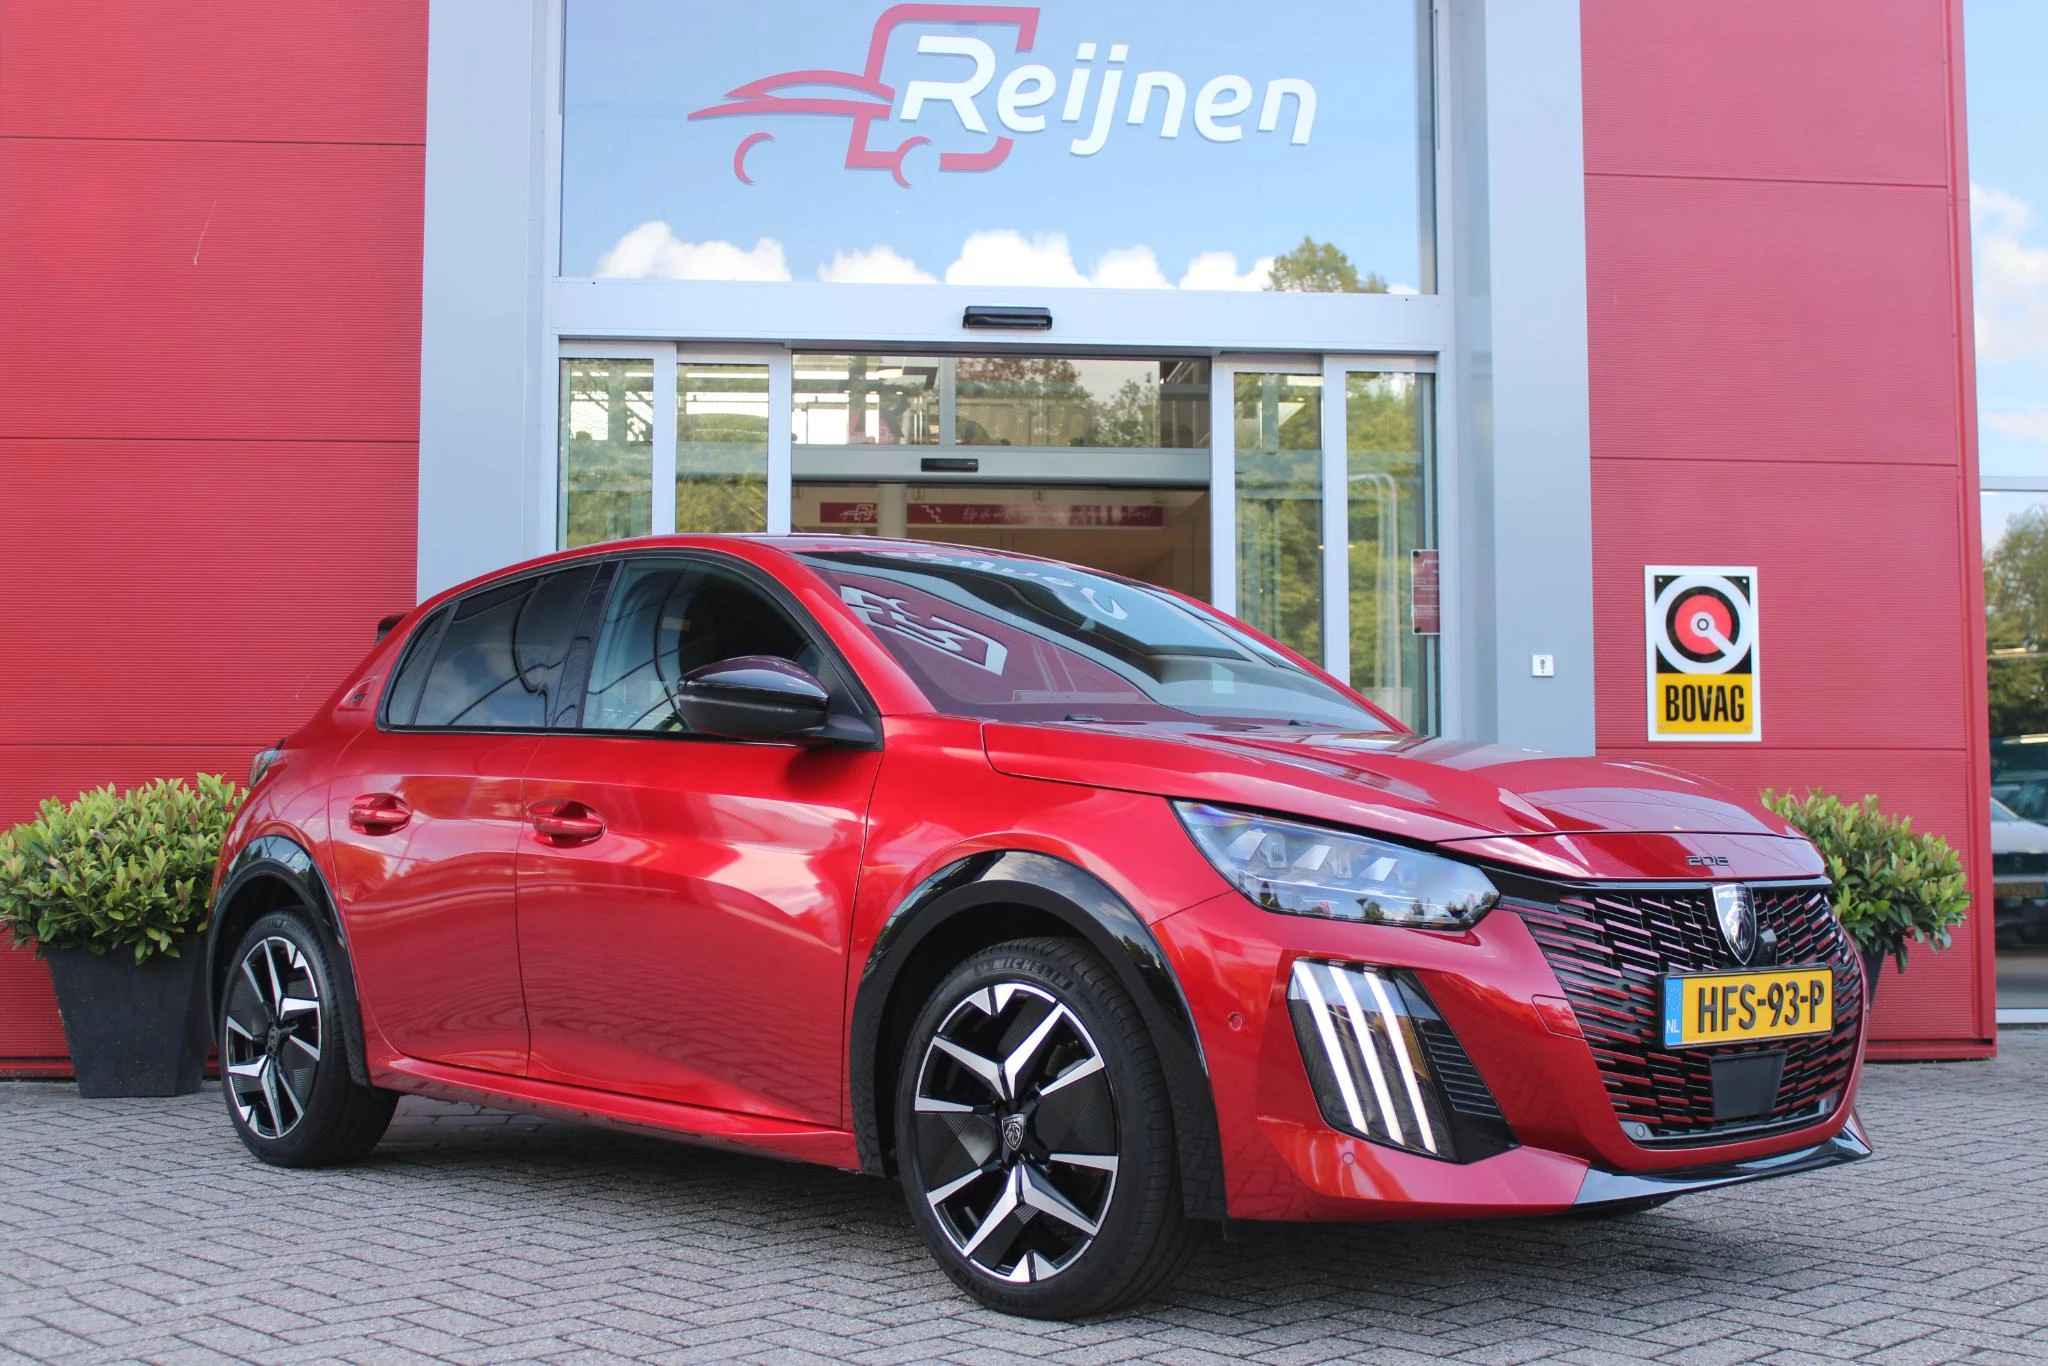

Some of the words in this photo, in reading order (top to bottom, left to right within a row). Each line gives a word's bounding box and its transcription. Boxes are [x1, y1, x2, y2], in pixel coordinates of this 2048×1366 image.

[900, 36, 1317, 155] Reijnen
[1665, 684, 1745, 723] BOVAG
[1686, 855, 1729, 867] 208
[993, 958, 1069, 988] MICHELIN
[1698, 979, 1825, 1033] HFS-93-P
[1666, 1019, 1680, 1033] NL
